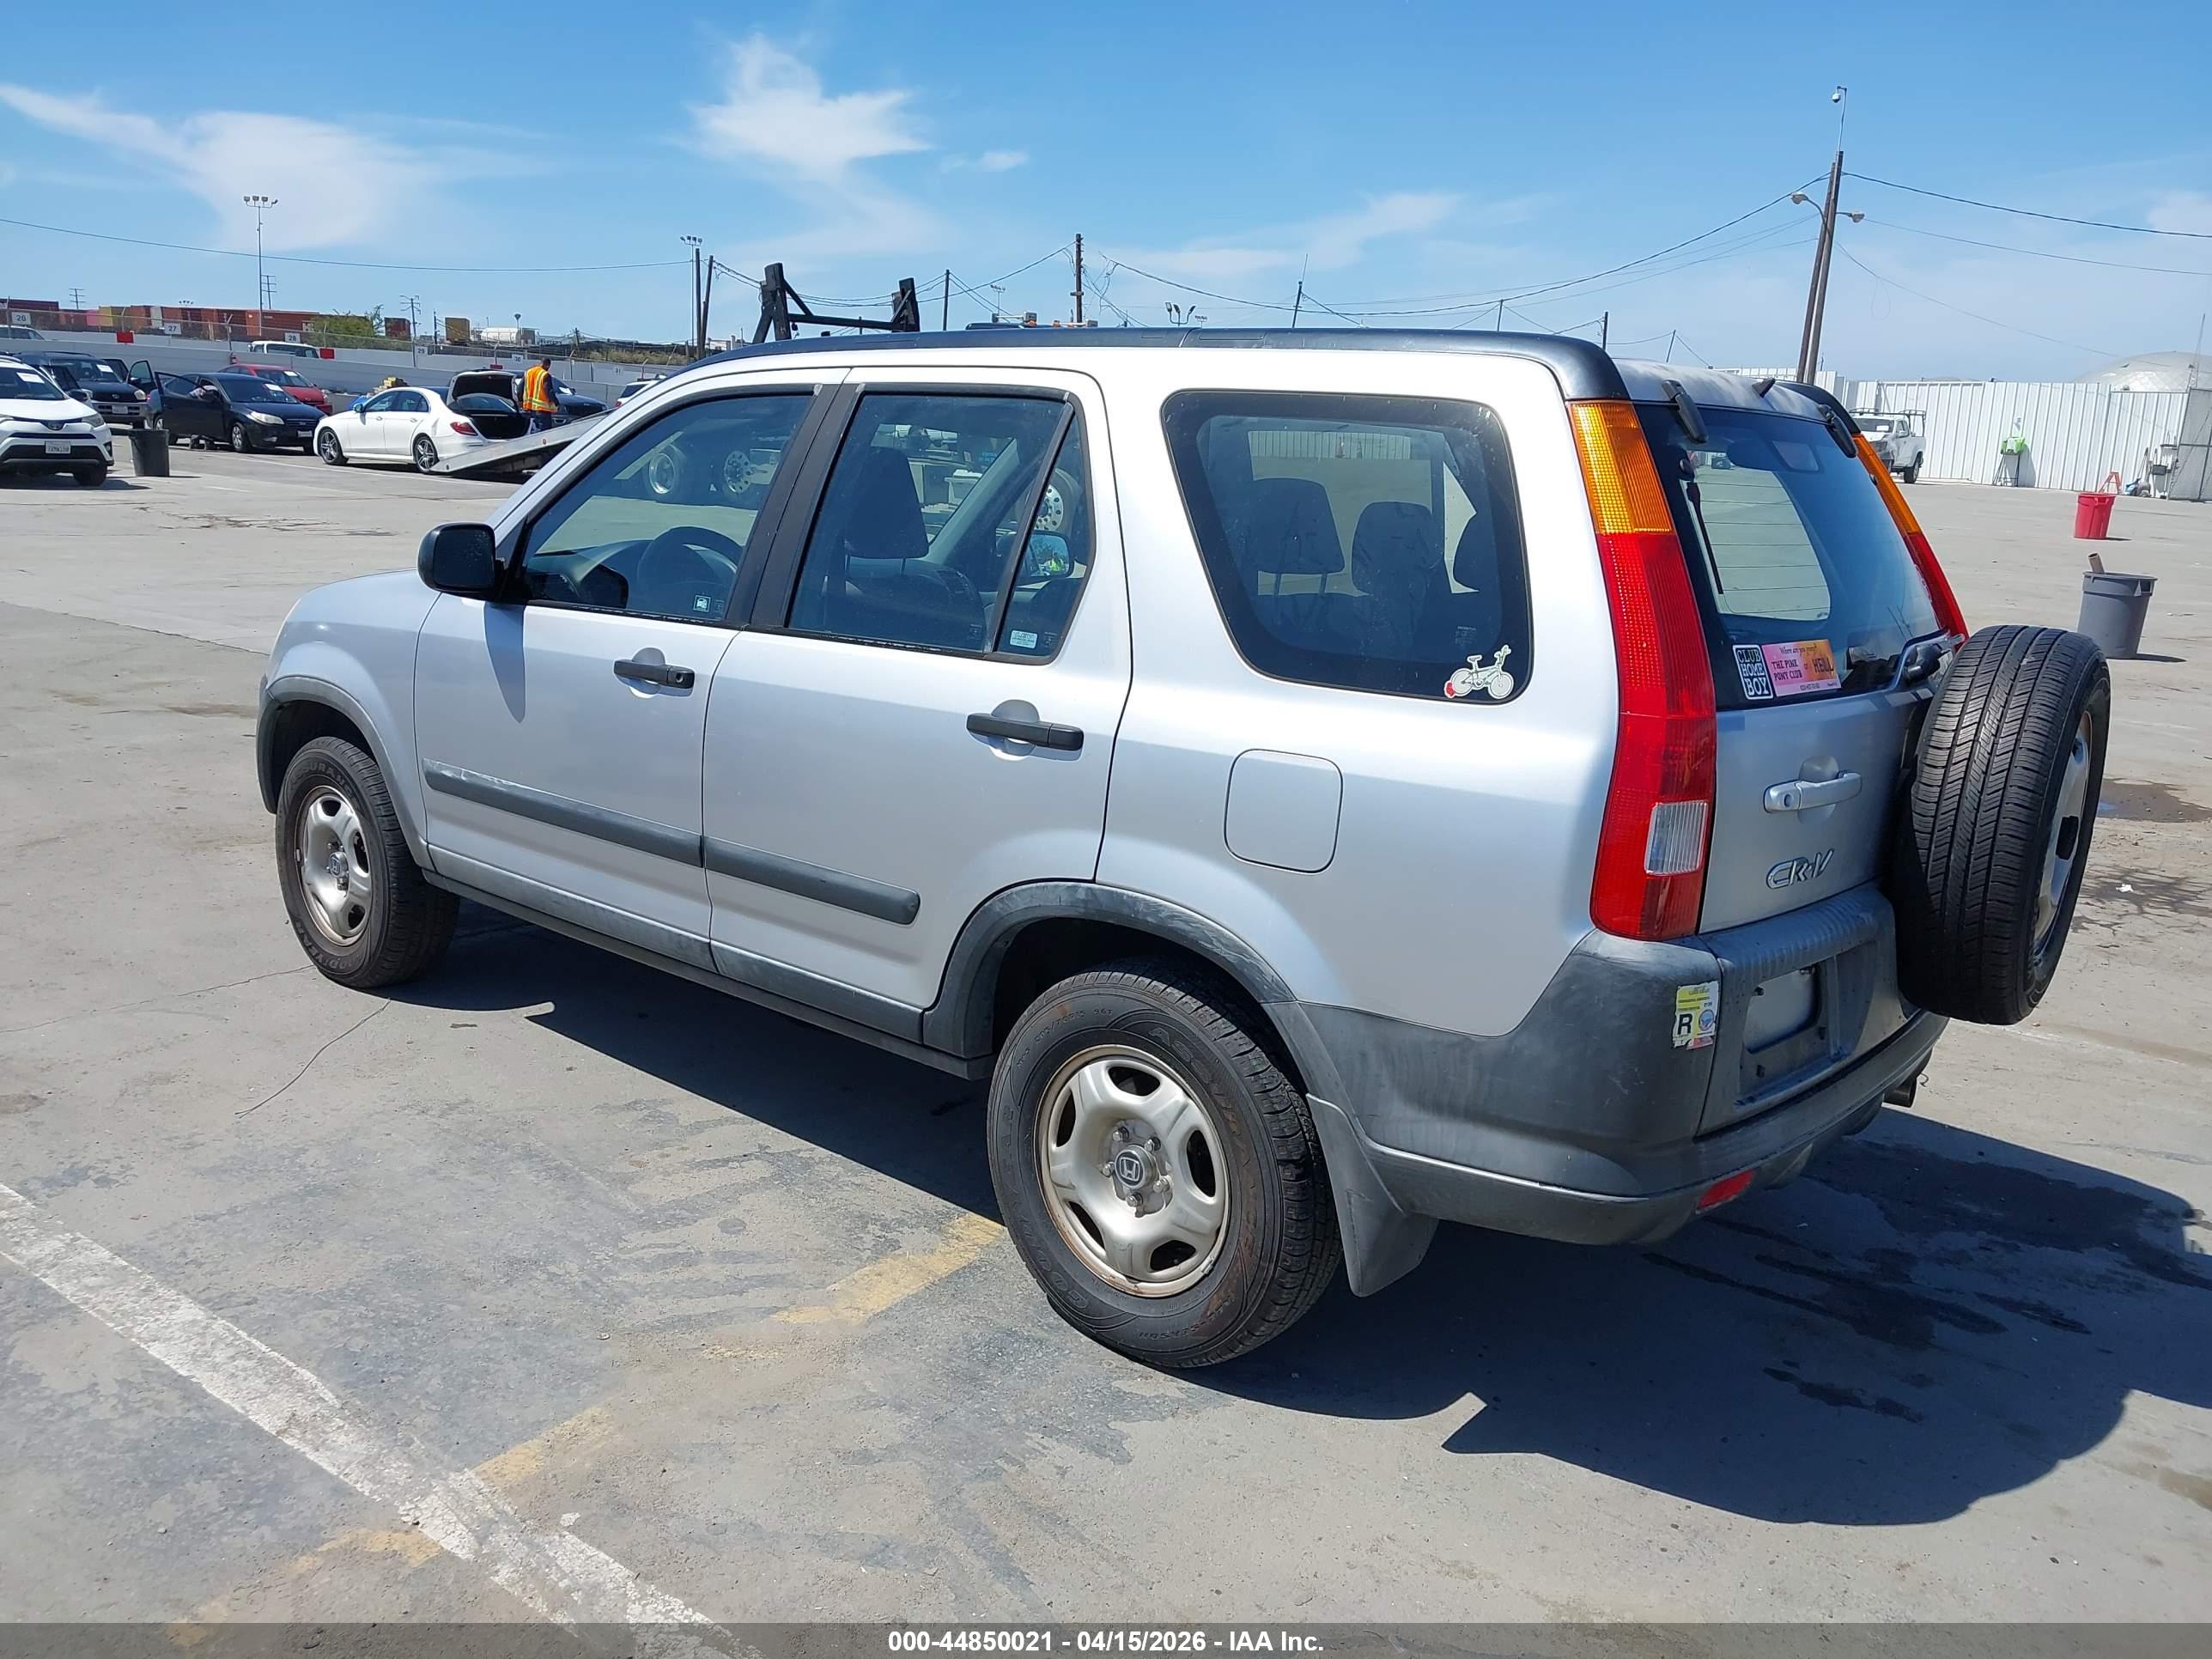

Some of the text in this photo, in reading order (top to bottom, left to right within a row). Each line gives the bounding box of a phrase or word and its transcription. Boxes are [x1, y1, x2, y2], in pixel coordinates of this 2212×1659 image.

[1737, 647, 1761, 664] CLUB
[1740, 663, 1765, 677] HOME
[1771, 659, 1799, 670] THE PINK
[1812, 657, 1834, 673] HELL
[1773, 669, 1802, 681] PONY CLUB
[1743, 677, 1770, 696] BOY
[1677, 1013, 1693, 1036] R
